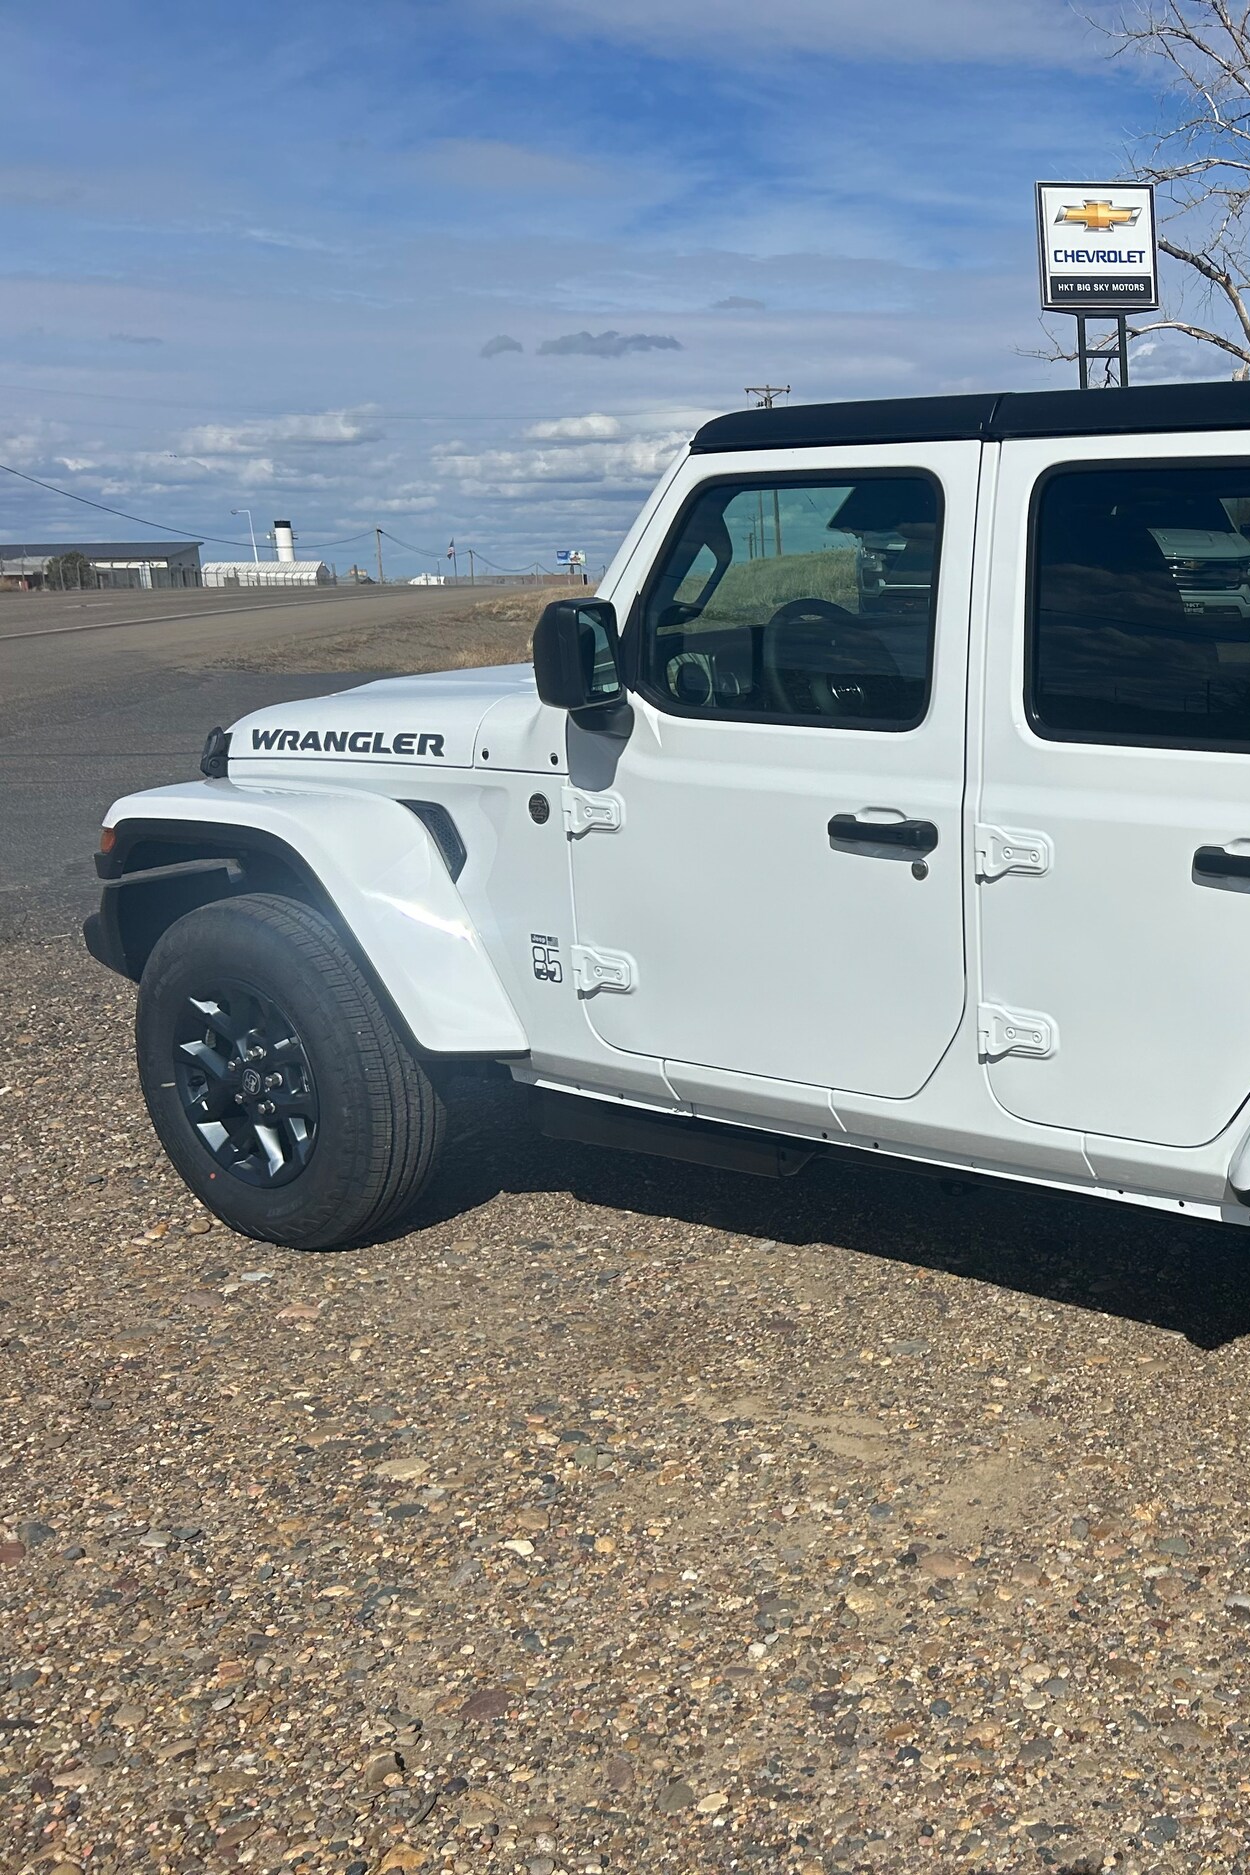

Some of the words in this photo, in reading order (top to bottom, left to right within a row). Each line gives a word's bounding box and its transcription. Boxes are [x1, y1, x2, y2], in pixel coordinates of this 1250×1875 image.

[1053, 249, 1146, 264] CHEVROLET
[1058, 283, 1074, 292] HKT
[1076, 283, 1091, 292] BIG
[1093, 283, 1110, 292] SKY
[1112, 283, 1145, 292] MOTORS
[251, 728, 445, 757] WRANGLER
